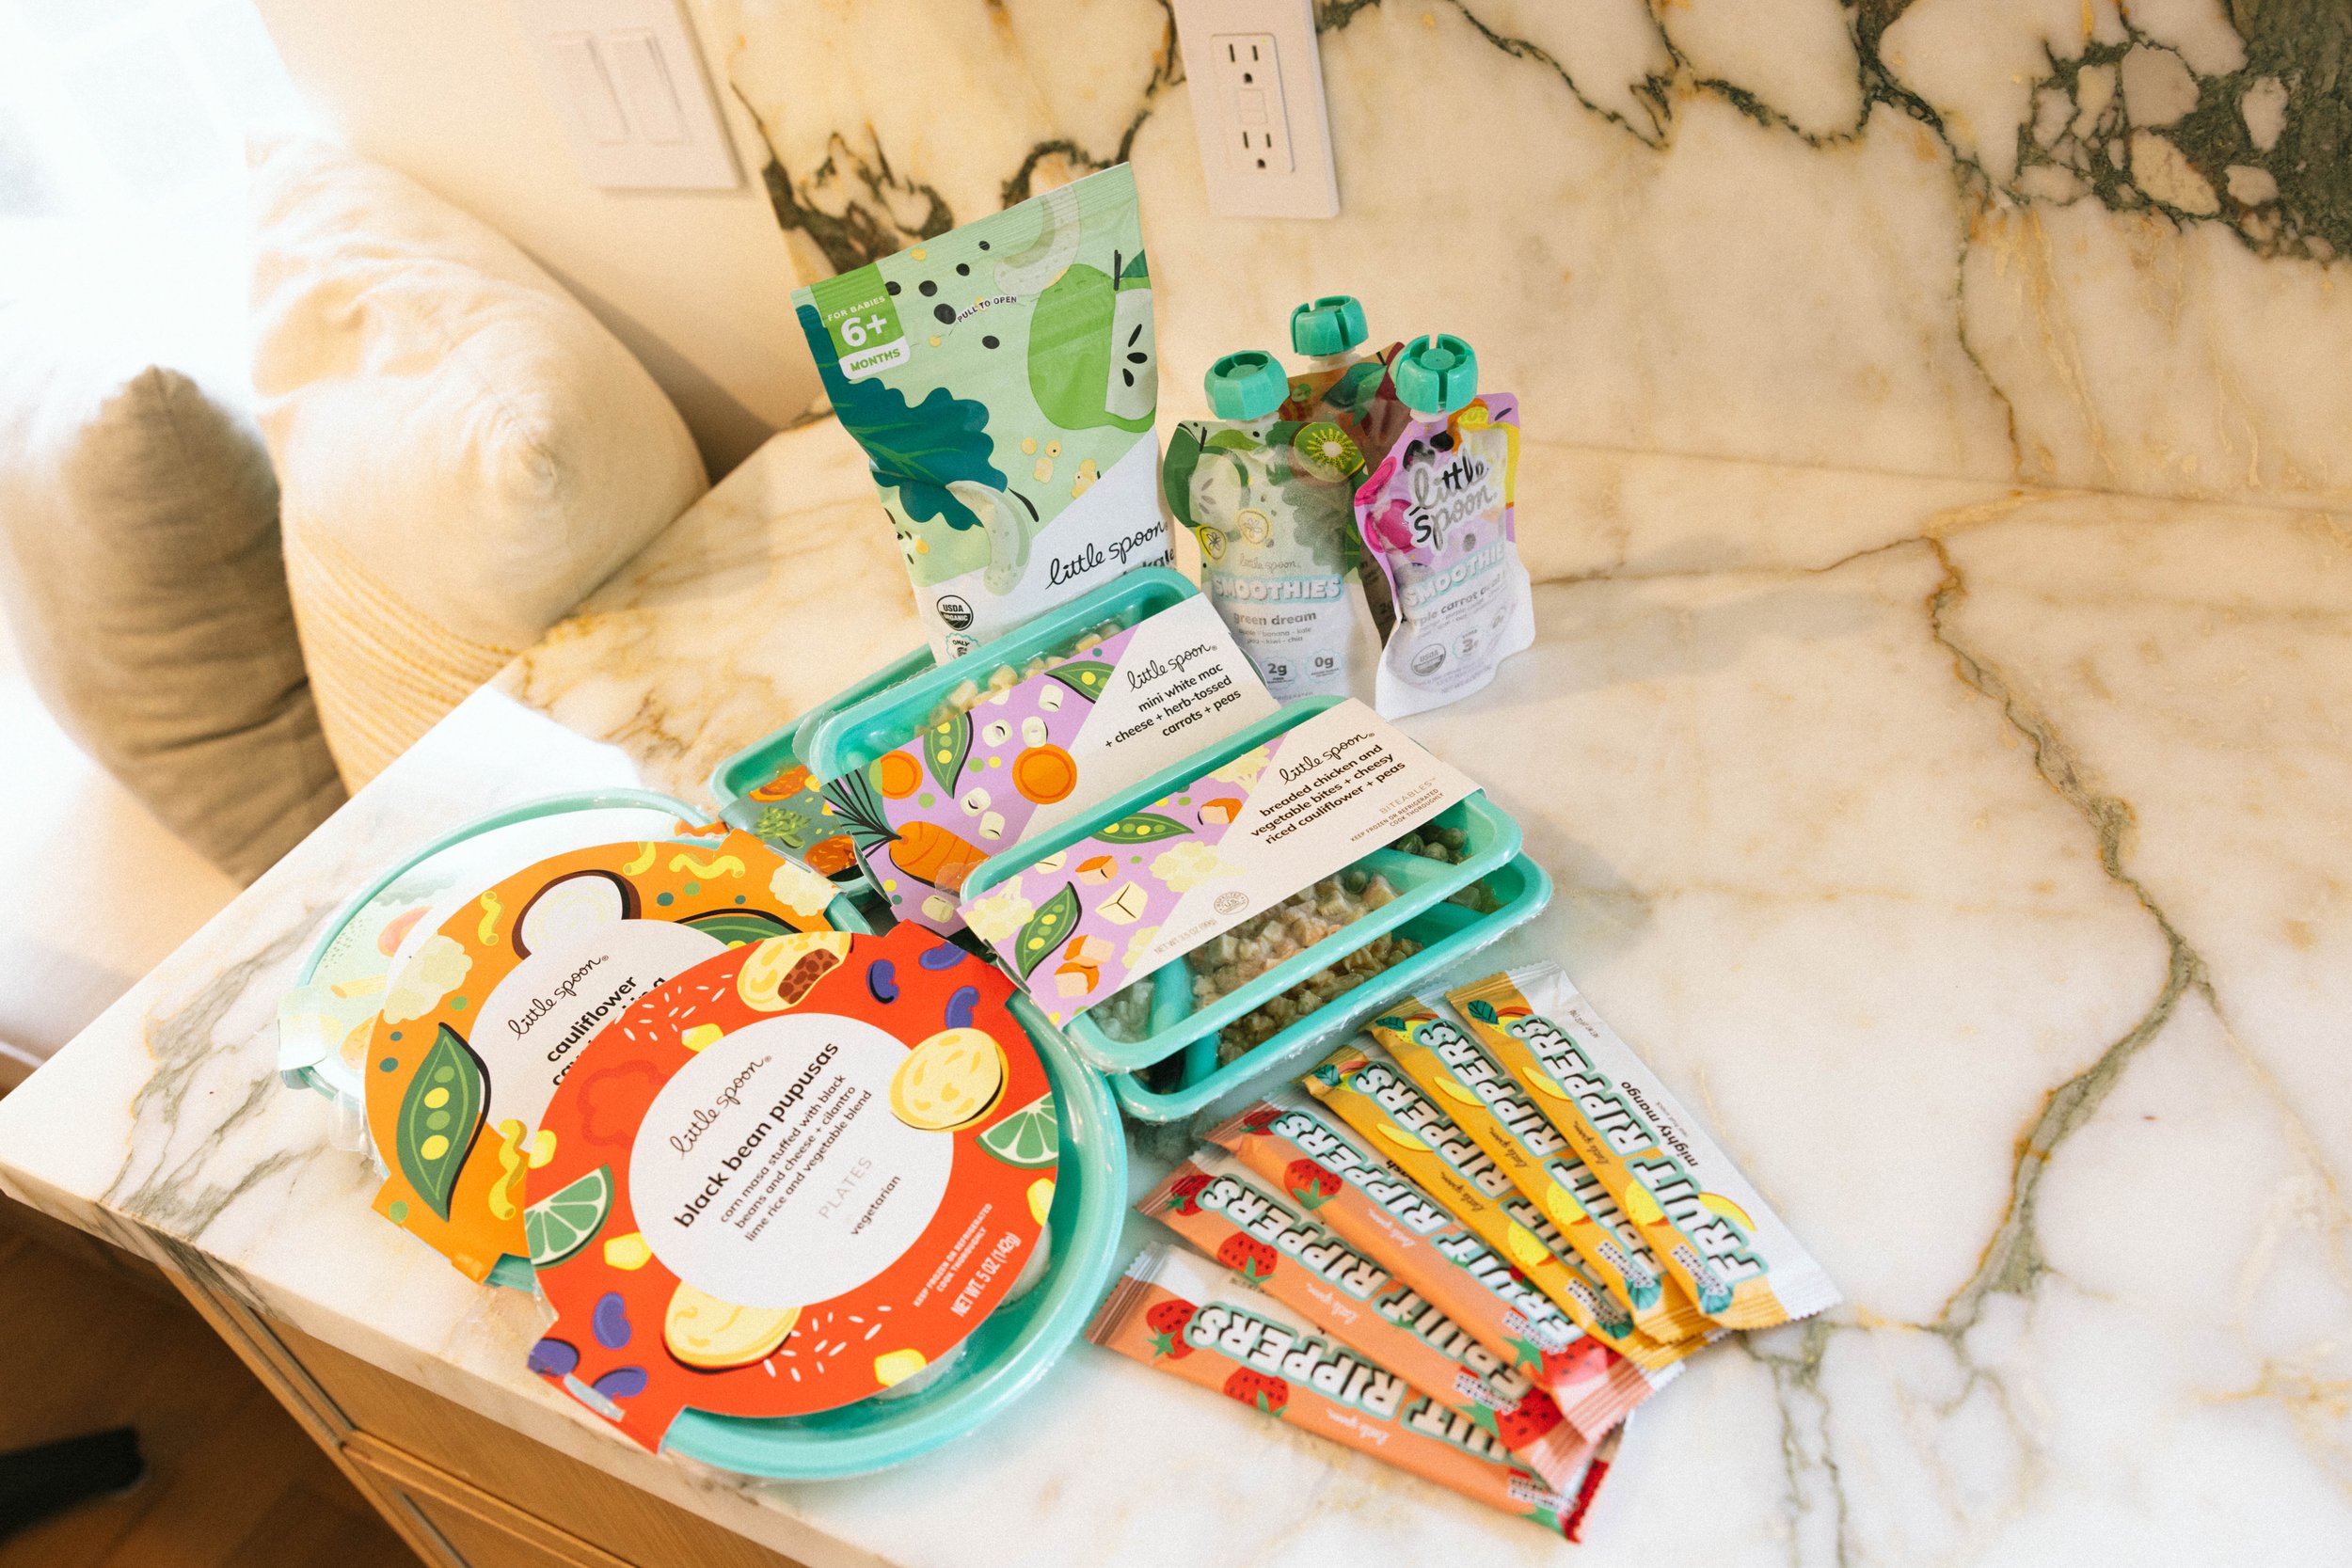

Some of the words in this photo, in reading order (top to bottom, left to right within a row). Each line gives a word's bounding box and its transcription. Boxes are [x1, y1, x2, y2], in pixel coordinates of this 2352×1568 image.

[828, 308, 848, 323] FOR
[850, 295, 887, 314] BABIES
[840, 313, 888, 347] 6+
[956, 306, 978, 324] PULL
[978, 299, 993, 309] TO
[993, 295, 1017, 306] OPEN
[850, 348, 901, 372] MONTHS
[1409, 448, 1490, 516] little
[1045, 543, 1106, 590] little
[1214, 575, 1342, 601] SMOOTHIES
[943, 604, 964, 613] USDA
[1233, 612, 1267, 626] green
[1271, 611, 1317, 626] dream
[1127, 659, 1169, 692] little
[1137, 691, 1165, 713] mini
[1164, 675, 1198, 699] white
[1198, 662, 1224, 682] mac
[1267, 663, 1288, 676] 2g
[1314, 657, 1334, 669] 0g
[1104, 739, 1114, 749] +
[1114, 718, 1155, 744] cheese
[1155, 712, 1164, 721] +
[1163, 674, 1233, 718] herb-tossed
[1162, 709, 1203, 737] carrots
[1204, 705, 1213, 714] +
[1215, 689, 1242, 712] peas
[1250, 800, 1312, 839] vegetable
[1313, 782, 1344, 804] bites
[1343, 777, 1353, 785] +
[1353, 753, 1395, 780] cheesy
[1259, 784, 1312, 817] breaded
[1312, 758, 1359, 788] chicken
[1359, 744, 1385, 763] and
[1279, 755, 1324, 785] little
[1264, 823, 1298, 845] riced
[1298, 784, 1364, 826] cauliflower
[1365, 780, 1375, 788] +
[1375, 760, 1406, 784] peas
[1350, 831, 1366, 842] KEEP
[1365, 818, 1390, 834] FROZEN
[1388, 813, 1400, 822] OR
[1398, 787, 1439, 816] REFRIGERATED
[1389, 816, 1407, 828] COOK
[1405, 792, 1445, 819] THOROUGHLY
[507, 998, 557, 1041] little
[547, 975, 638, 1064] cauliflower
[1420, 1021, 1568, 1156] RIPPERS
[1512, 1019, 1654, 1155] RIPPERS
[1621, 1081, 1661, 1123] mango
[669, 1109, 720, 1159] little
[674, 1170, 730, 1228] black
[722, 1122, 772, 1171] bean
[769, 1042, 839, 1124] pupusas
[721, 1197, 743, 1223] corn
[742, 1166, 770, 1199] masa
[768, 1127, 802, 1166] stuffed
[800, 1102, 822, 1129] with
[818, 1074, 847, 1107] black
[735, 1195, 768, 1228] beans
[766, 1171, 787, 1195] and
[784, 1133, 817, 1170] cheese
[816, 1125, 824, 1134] +
[821, 1085, 856, 1127] cilantro
[1356, 1064, 1518, 1198] RIPPERS
[1659, 1125, 1699, 1167] mighty
[744, 1216, 770, 1242] lime
[768, 1194, 787, 1217] rice
[786, 1171, 805, 1196] and
[804, 1119, 849, 1172] vegetable
[846, 1089, 873, 1121] blend
[818, 1156, 873, 1220] PLATES
[1276, 1114, 1449, 1234] RIPPERS
[850, 1175, 901, 1237] vegetarian
[1551, 1161, 1668, 1276] FRUIT
[1632, 1160, 1763, 1283] FRUIT
[992, 1230, 1022, 1264] (142g)
[1202, 1178, 1391, 1298] RIPPERS
[975, 1270, 992, 1283] 5
[981, 1257, 1002, 1275] OZ
[1438, 1235, 1585, 1344] FRUIT
[950, 1286, 975, 1318] NET
[1191, 1306, 1407, 1418] RIPPERS
[1408, 1397, 1508, 1462] UIT
